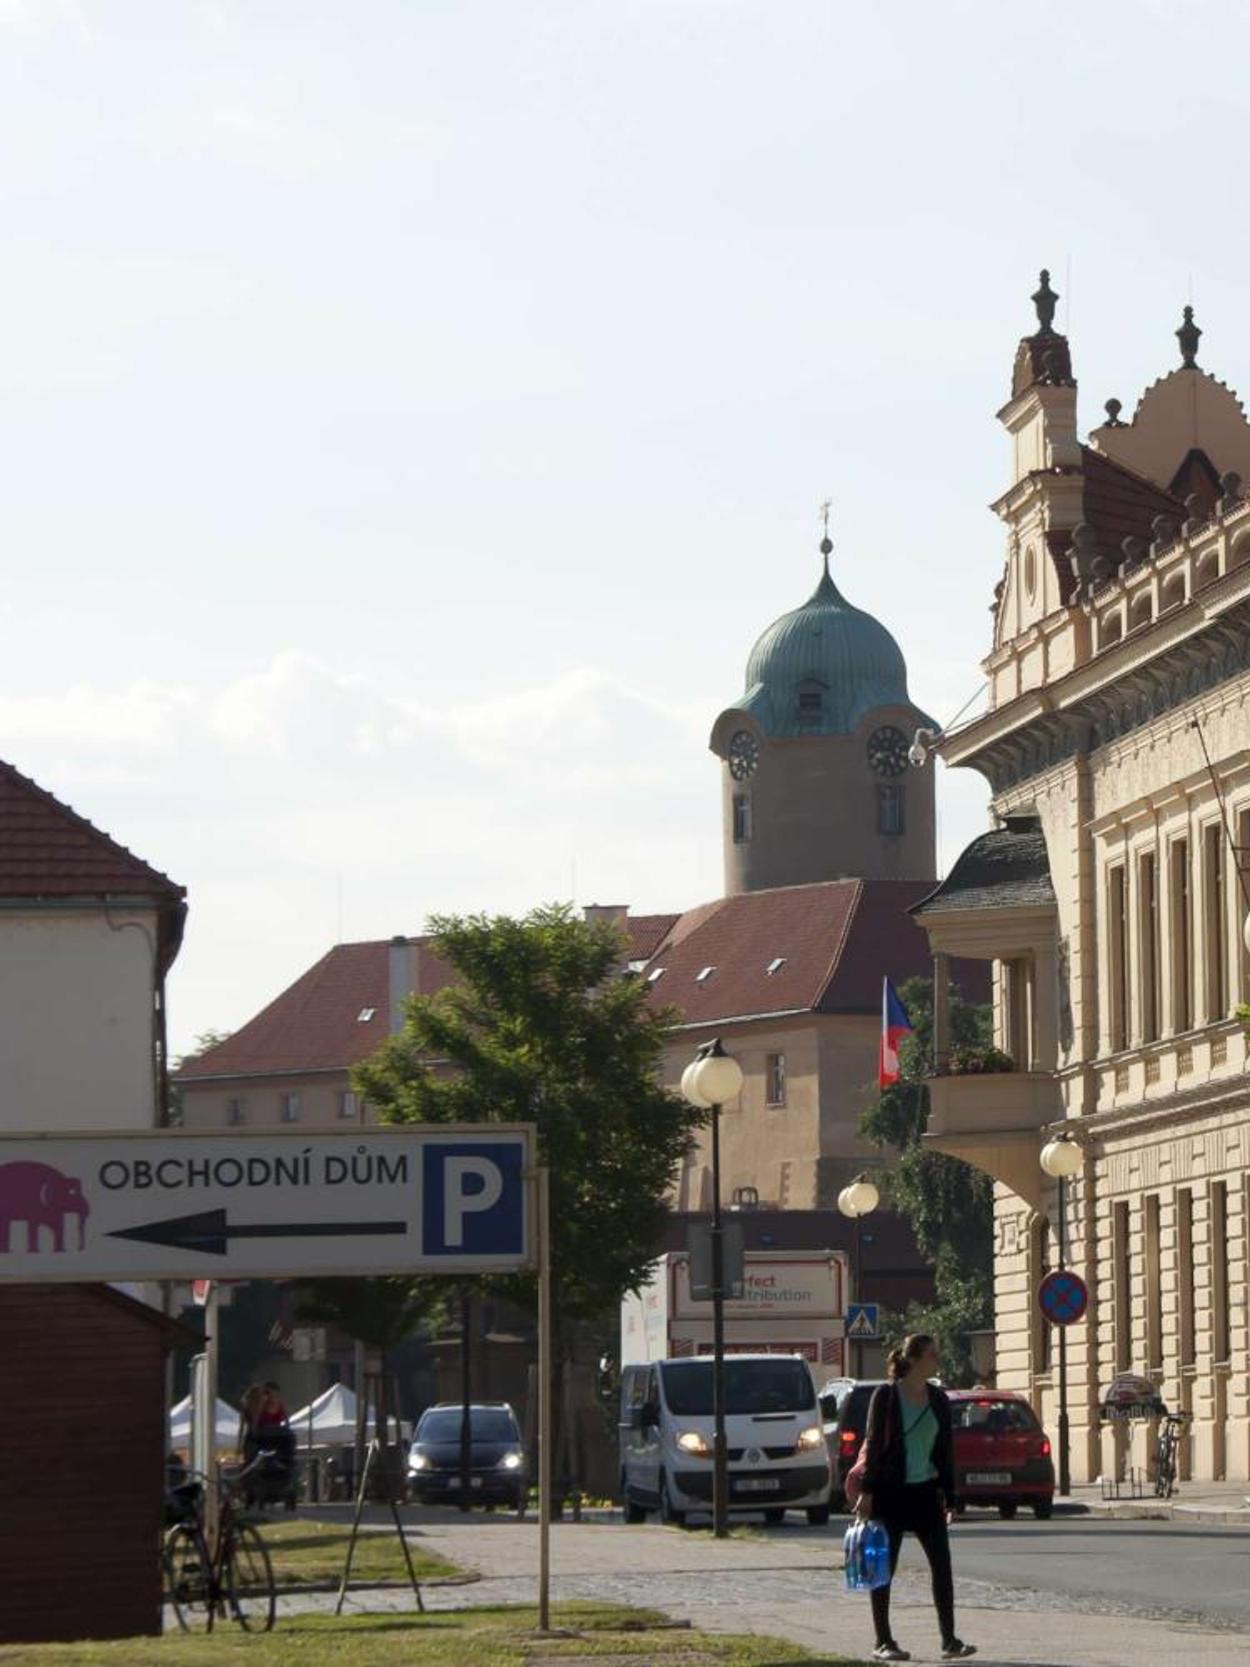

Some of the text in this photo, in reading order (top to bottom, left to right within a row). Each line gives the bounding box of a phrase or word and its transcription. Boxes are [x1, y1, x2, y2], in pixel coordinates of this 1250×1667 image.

[99, 1145, 409, 1191] OBCHODNÍ DŮM
[443, 1155, 503, 1248] P
[744, 1286, 812, 1302] tribution
